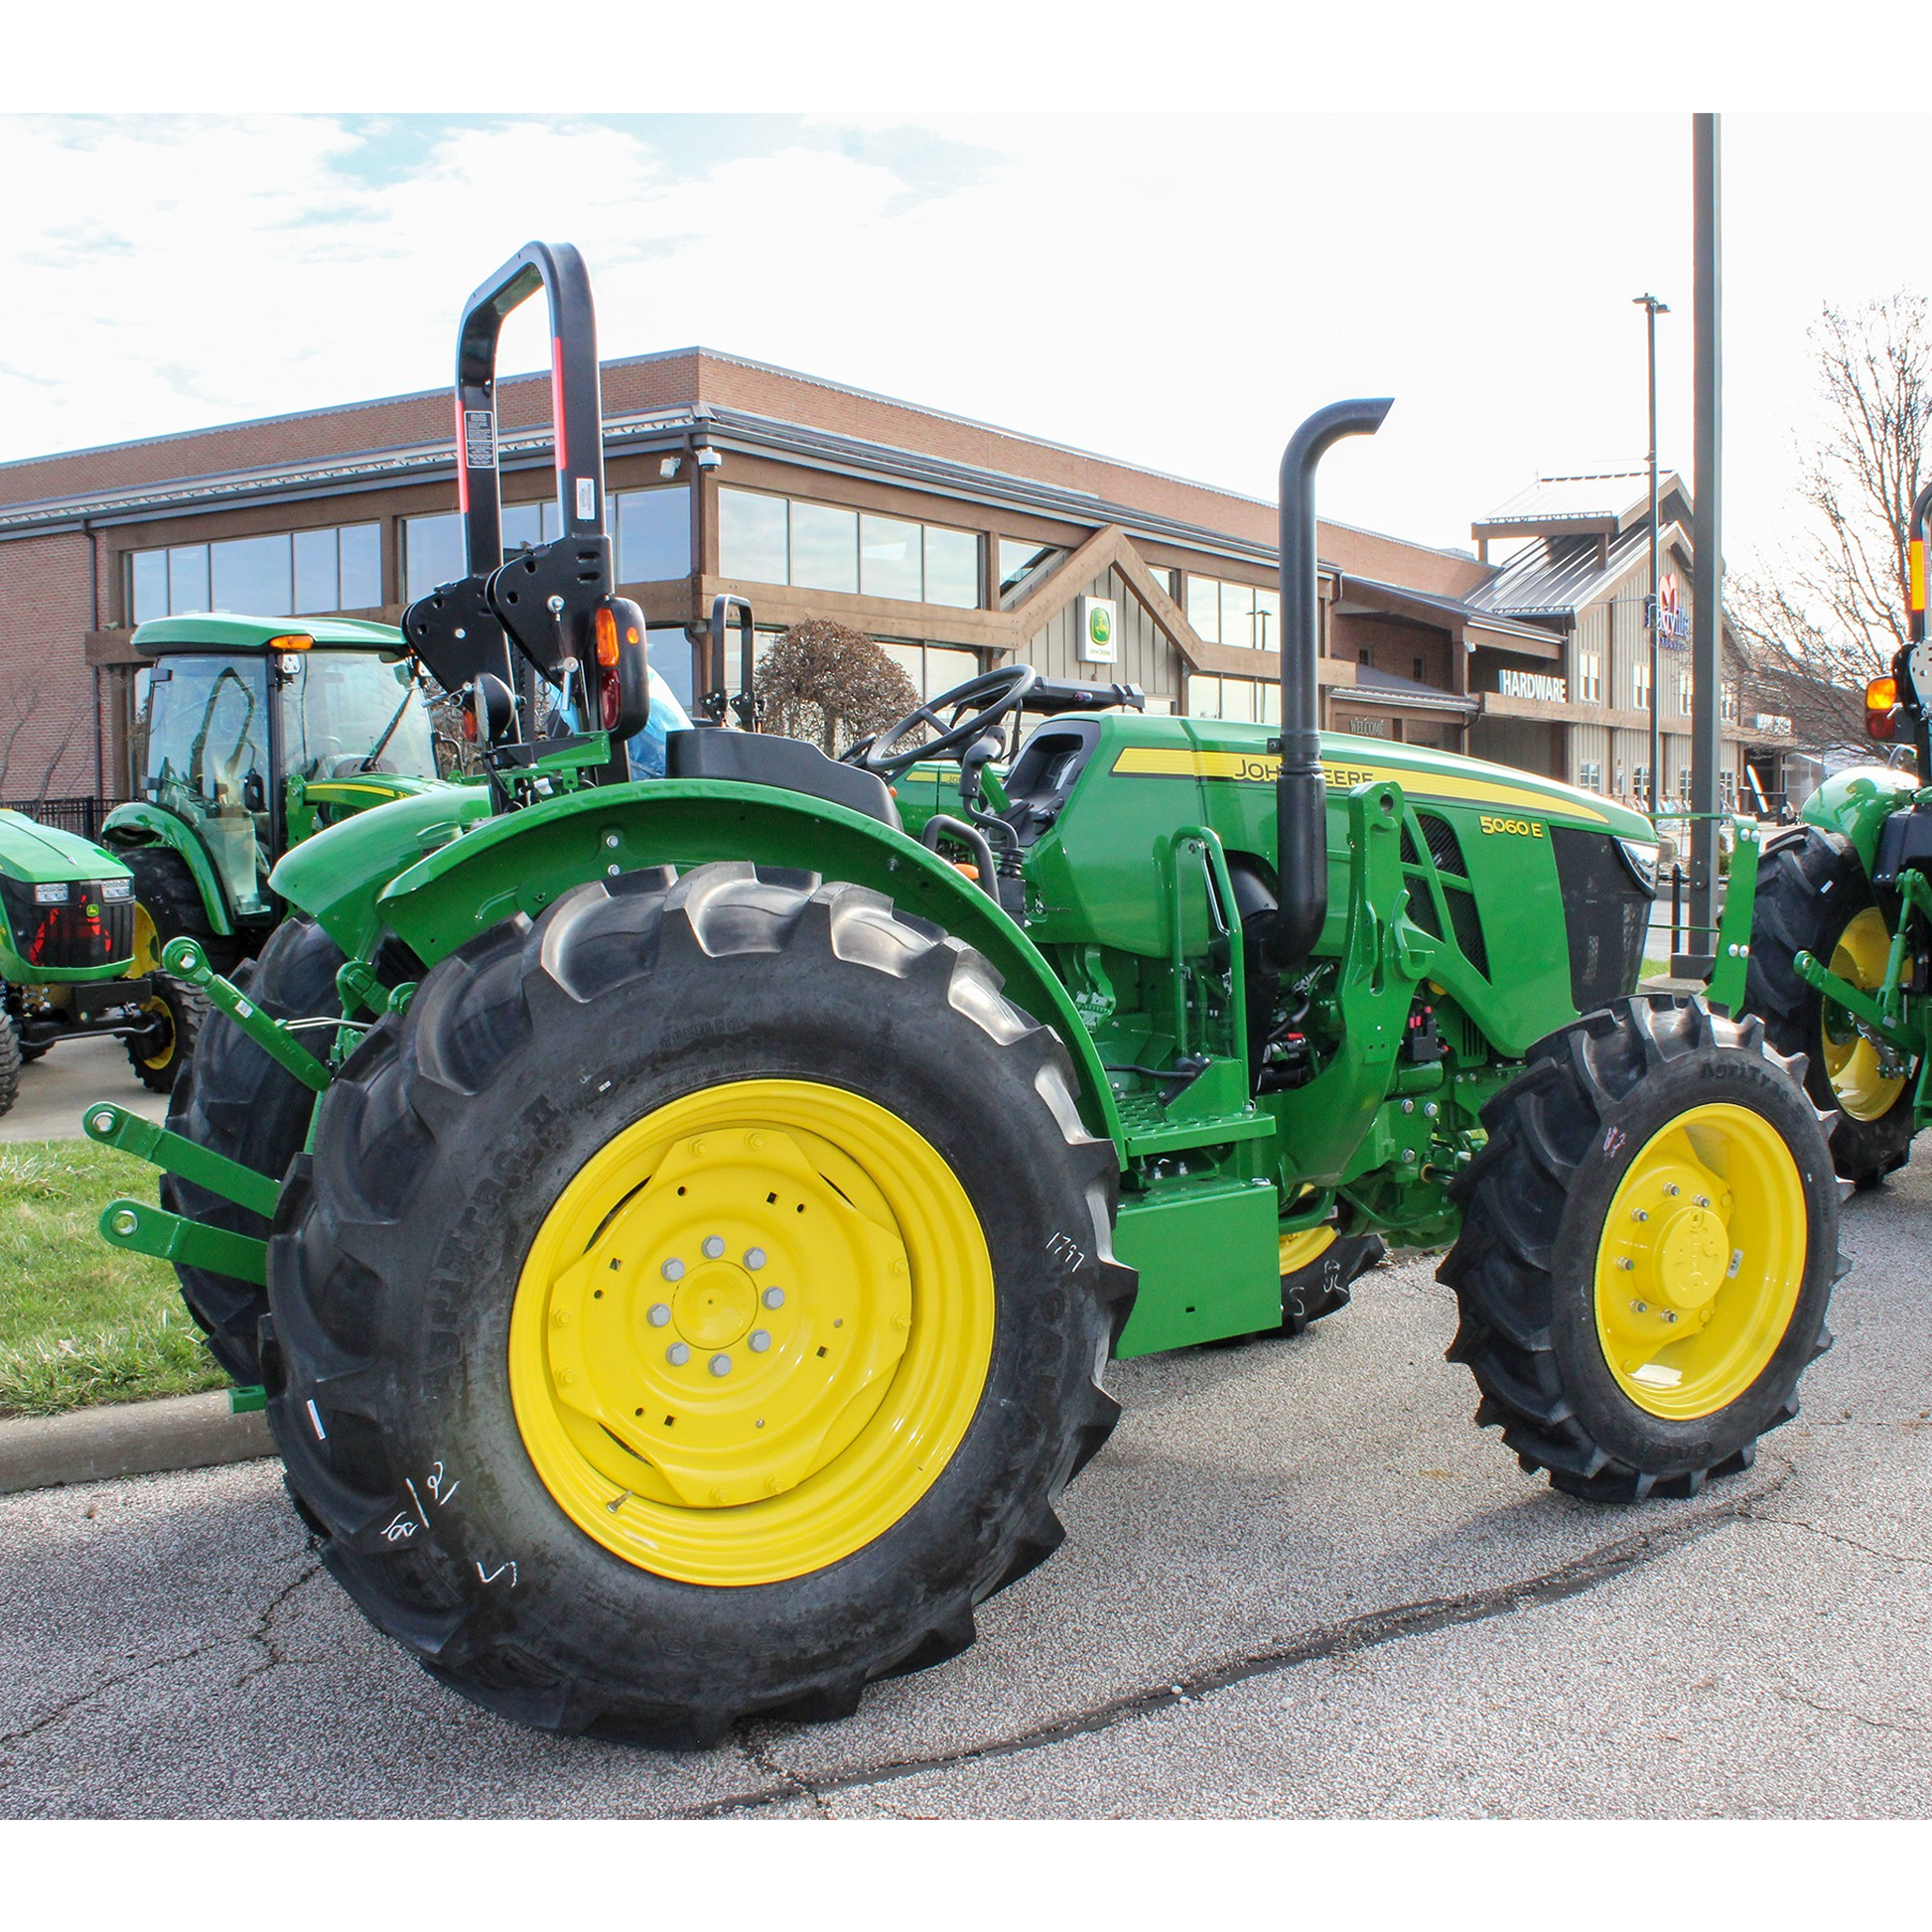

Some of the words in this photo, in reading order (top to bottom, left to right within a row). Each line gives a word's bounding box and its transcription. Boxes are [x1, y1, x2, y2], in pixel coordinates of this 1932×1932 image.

[1500, 669, 1567, 704] HARDWARE
[1349, 720, 1385, 736] WELCOME
[1235, 759, 1281, 780] JOH
[1324, 768, 1374, 786] EERE
